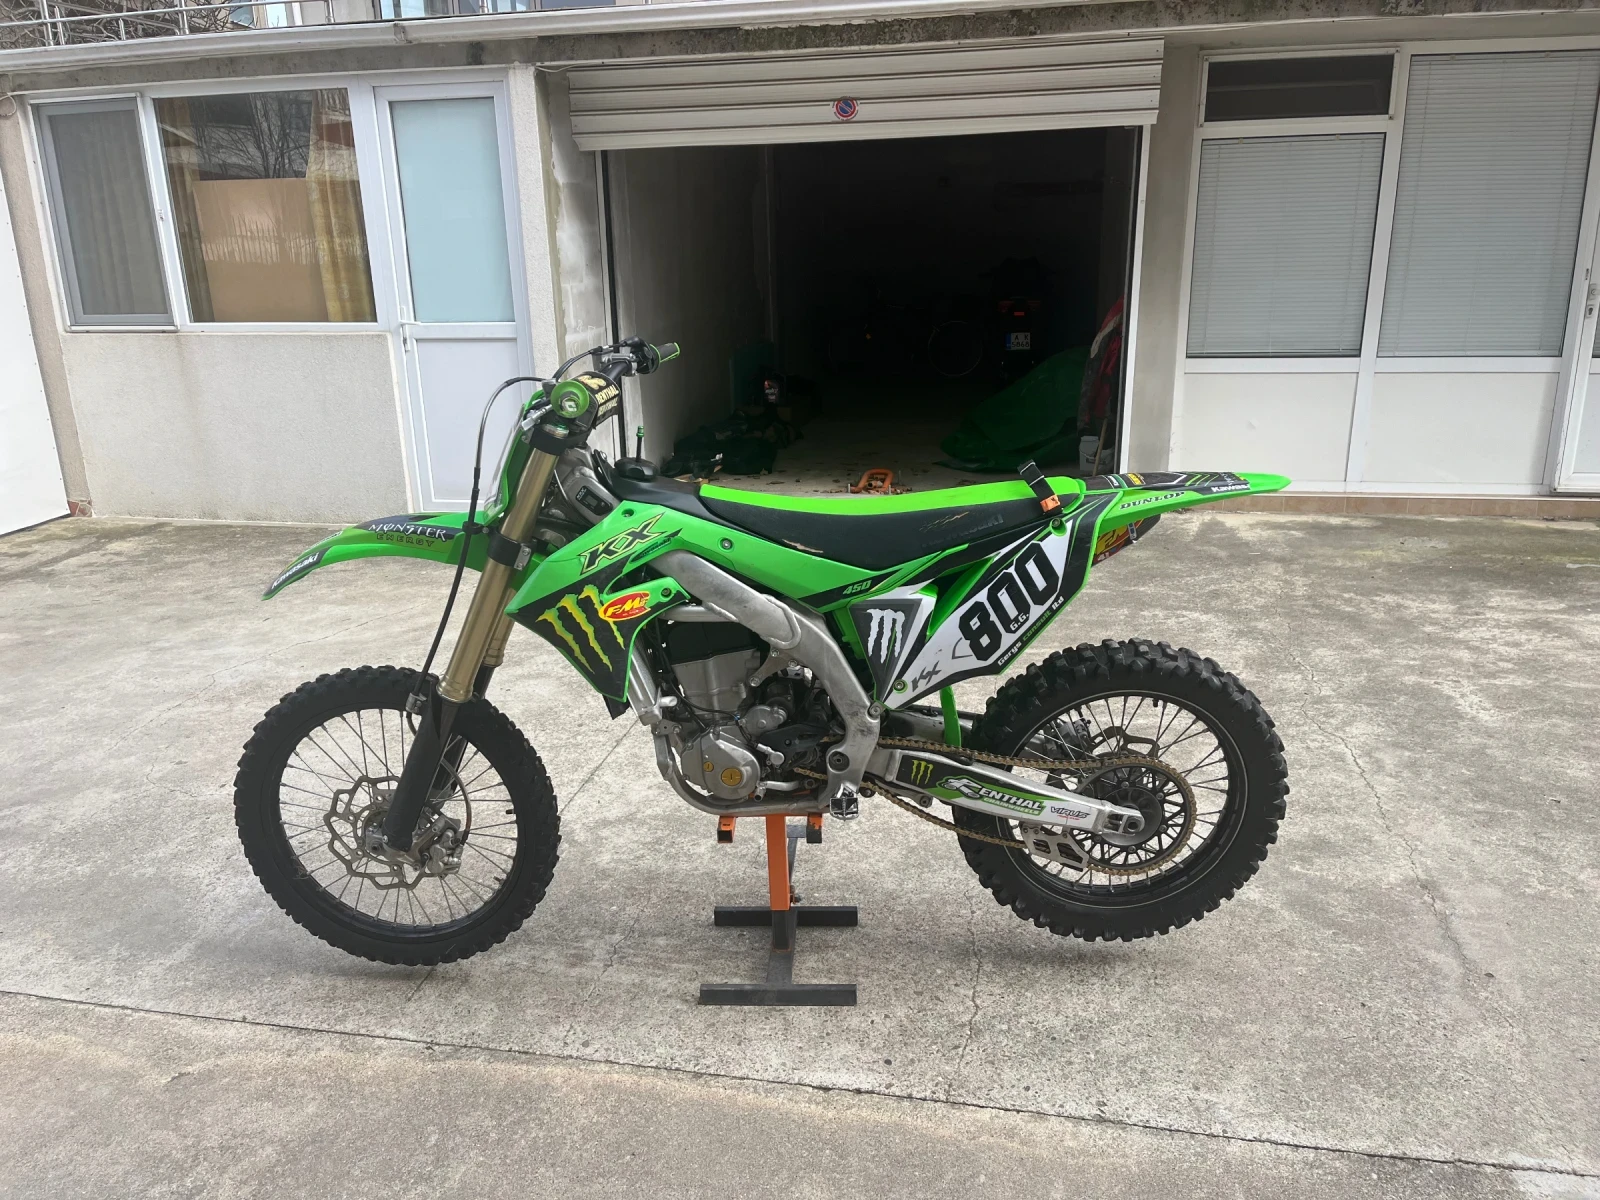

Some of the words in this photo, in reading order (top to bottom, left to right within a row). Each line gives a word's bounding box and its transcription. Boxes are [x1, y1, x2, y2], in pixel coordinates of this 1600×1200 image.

[1119, 491, 1185, 510] DUNLOP
[368, 522, 447, 542] MONSTER
[376, 533, 435, 548] ENERGY
[577, 511, 668, 575] KX
[271, 552, 319, 589] Kawasaki
[842, 580, 873, 595] 450
[958, 541, 1060, 662] 800
[997, 642, 1022, 666] Gerys
[1022, 610, 1052, 641] consult
[911, 661, 942, 692] KX
[983, 797, 1041, 816] CHAINWHEELS
[1050, 806, 1091, 820] VIRUS
